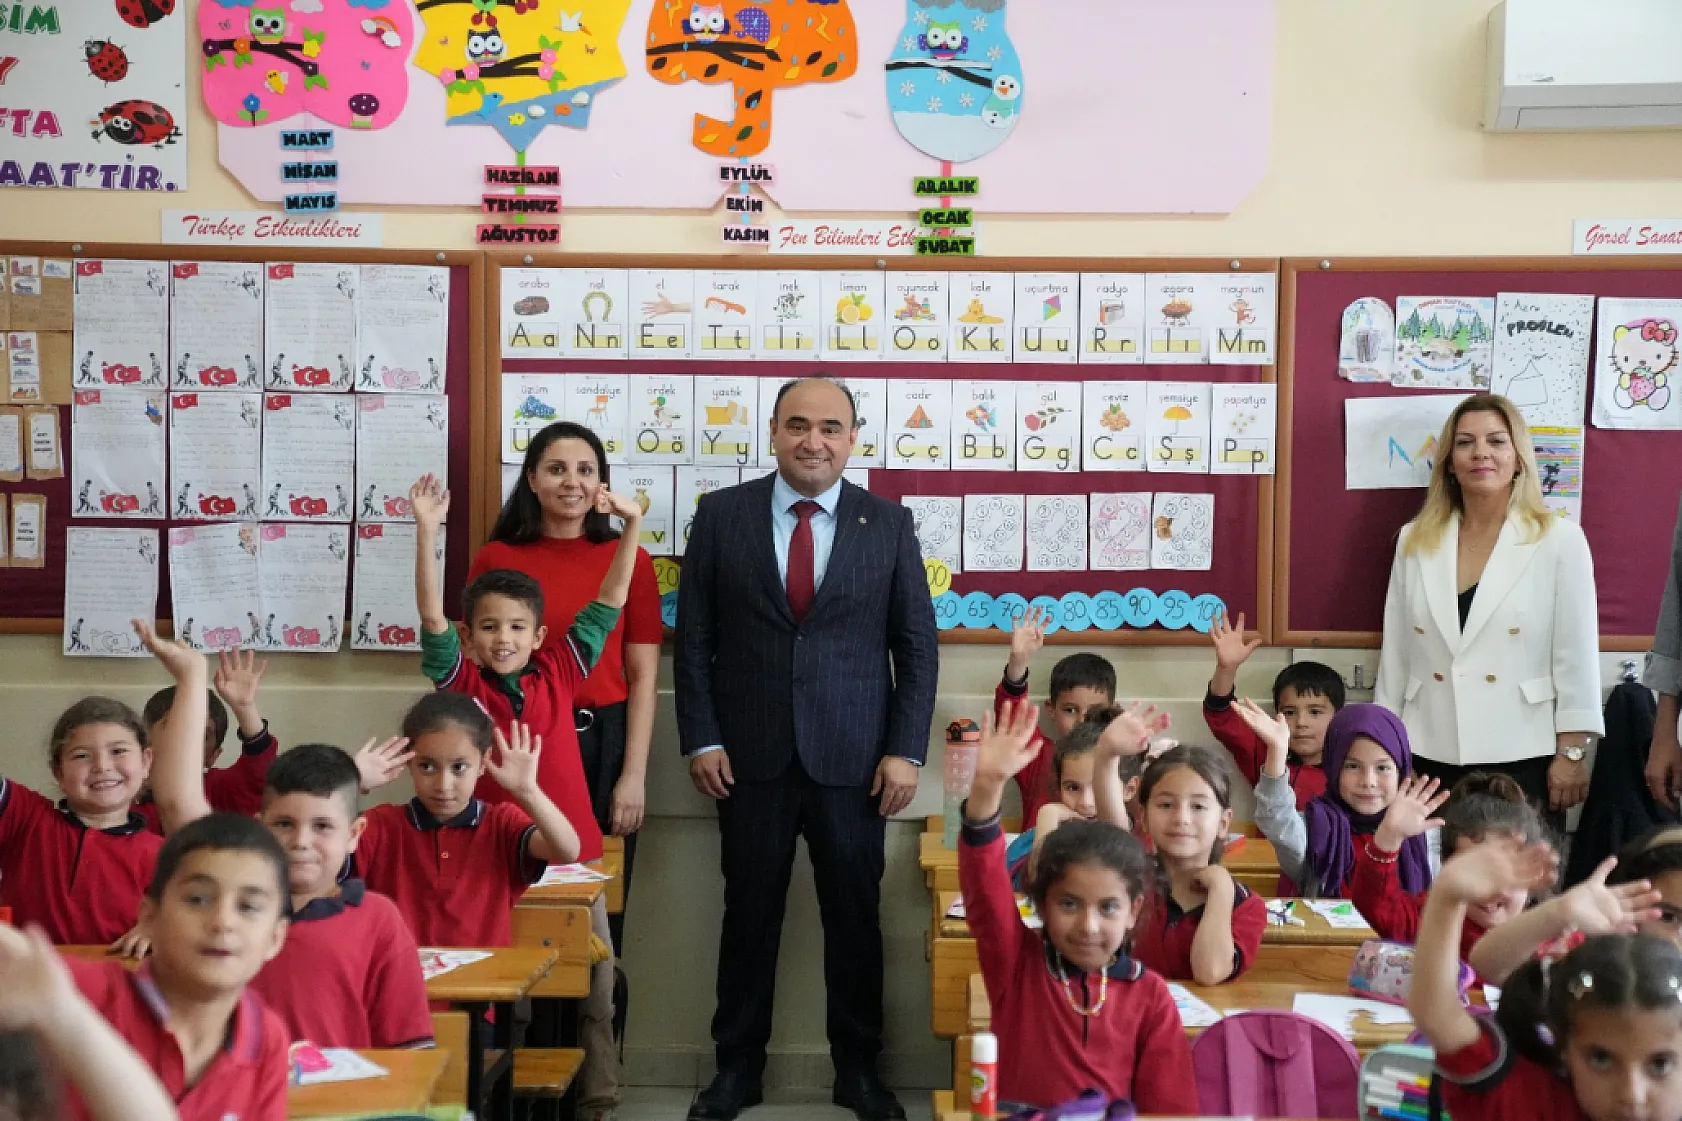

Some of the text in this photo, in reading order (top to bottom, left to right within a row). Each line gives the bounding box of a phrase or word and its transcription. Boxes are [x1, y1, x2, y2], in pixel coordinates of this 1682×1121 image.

[283, 132, 331, 146] MART
[284, 163, 336, 178] NİSAN
[487, 167, 558, 185] HAZİRAN
[720, 166, 772, 181] EYLÜL
[916, 179, 977, 193] ARALIK
[285, 195, 336, 209] MAYIS
[484, 198, 558, 213] TEMMUZ
[726, 195, 763, 212] EKİM
[923, 210, 969, 224] OCAK
[182, 215, 362, 241] Türkçe Etkinlikleri
[480, 225, 558, 242] AĞUSTOS
[723, 227, 769, 242] KASIM
[779, 225, 808, 249] Fen
[814, 225, 881, 247] Bilimleri
[1585, 224, 1632, 251] Görsel
[918, 239, 972, 254] ŞUBAT
[589, 277, 605, 290] nal
[655, 277, 665, 290] el
[779, 279, 800, 291] inek
[839, 280, 868, 292] limon
[896, 280, 939, 296] oyuncak
[970, 280, 992, 292] kale
[1096, 281, 1128, 298] radyo
[1220, 286, 1265, 298] maymun
[1223, 395, 1267, 409] papatya
[655, 564, 679, 587] 20
[935, 598, 957, 618] 60
[968, 600, 990, 618] 65
[1001, 600, 1024, 620] 70
[1063, 600, 1087, 622] 80
[1096, 599, 1119, 620] 85
[1129, 595, 1152, 616] 90
[1163, 596, 1188, 619] 95
